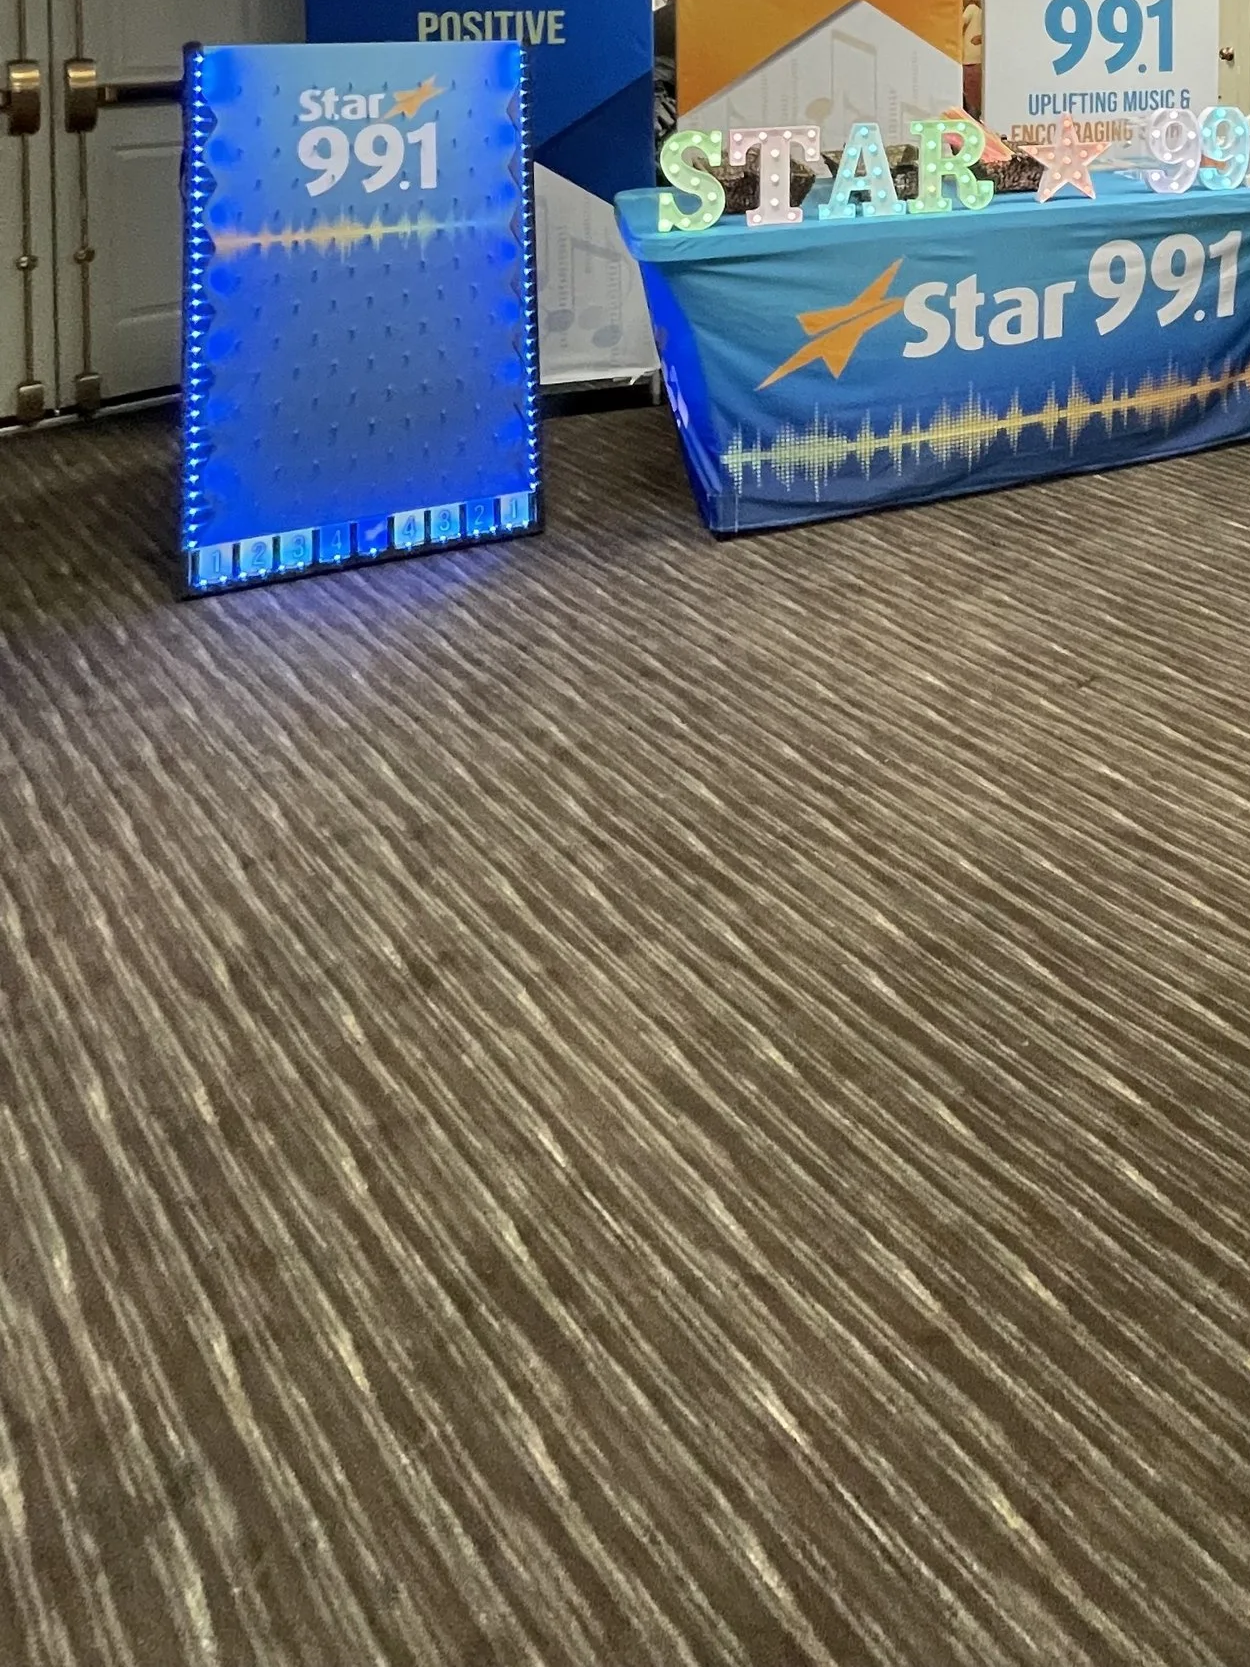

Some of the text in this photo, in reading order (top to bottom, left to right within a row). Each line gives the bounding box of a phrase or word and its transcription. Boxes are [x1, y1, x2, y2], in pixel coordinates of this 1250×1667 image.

[418, 10, 566, 44] POSITIVE
[299, 87, 385, 121] Star
[1028, 89, 1190, 115] UPLIFTING MUSIC &
[298, 122, 437, 197] 99.1
[658, 120, 994, 232] STAR
[903, 231, 1242, 358] Star 99.1
[212, 497, 518, 573] 1 2 3 4 4 3 2 1
